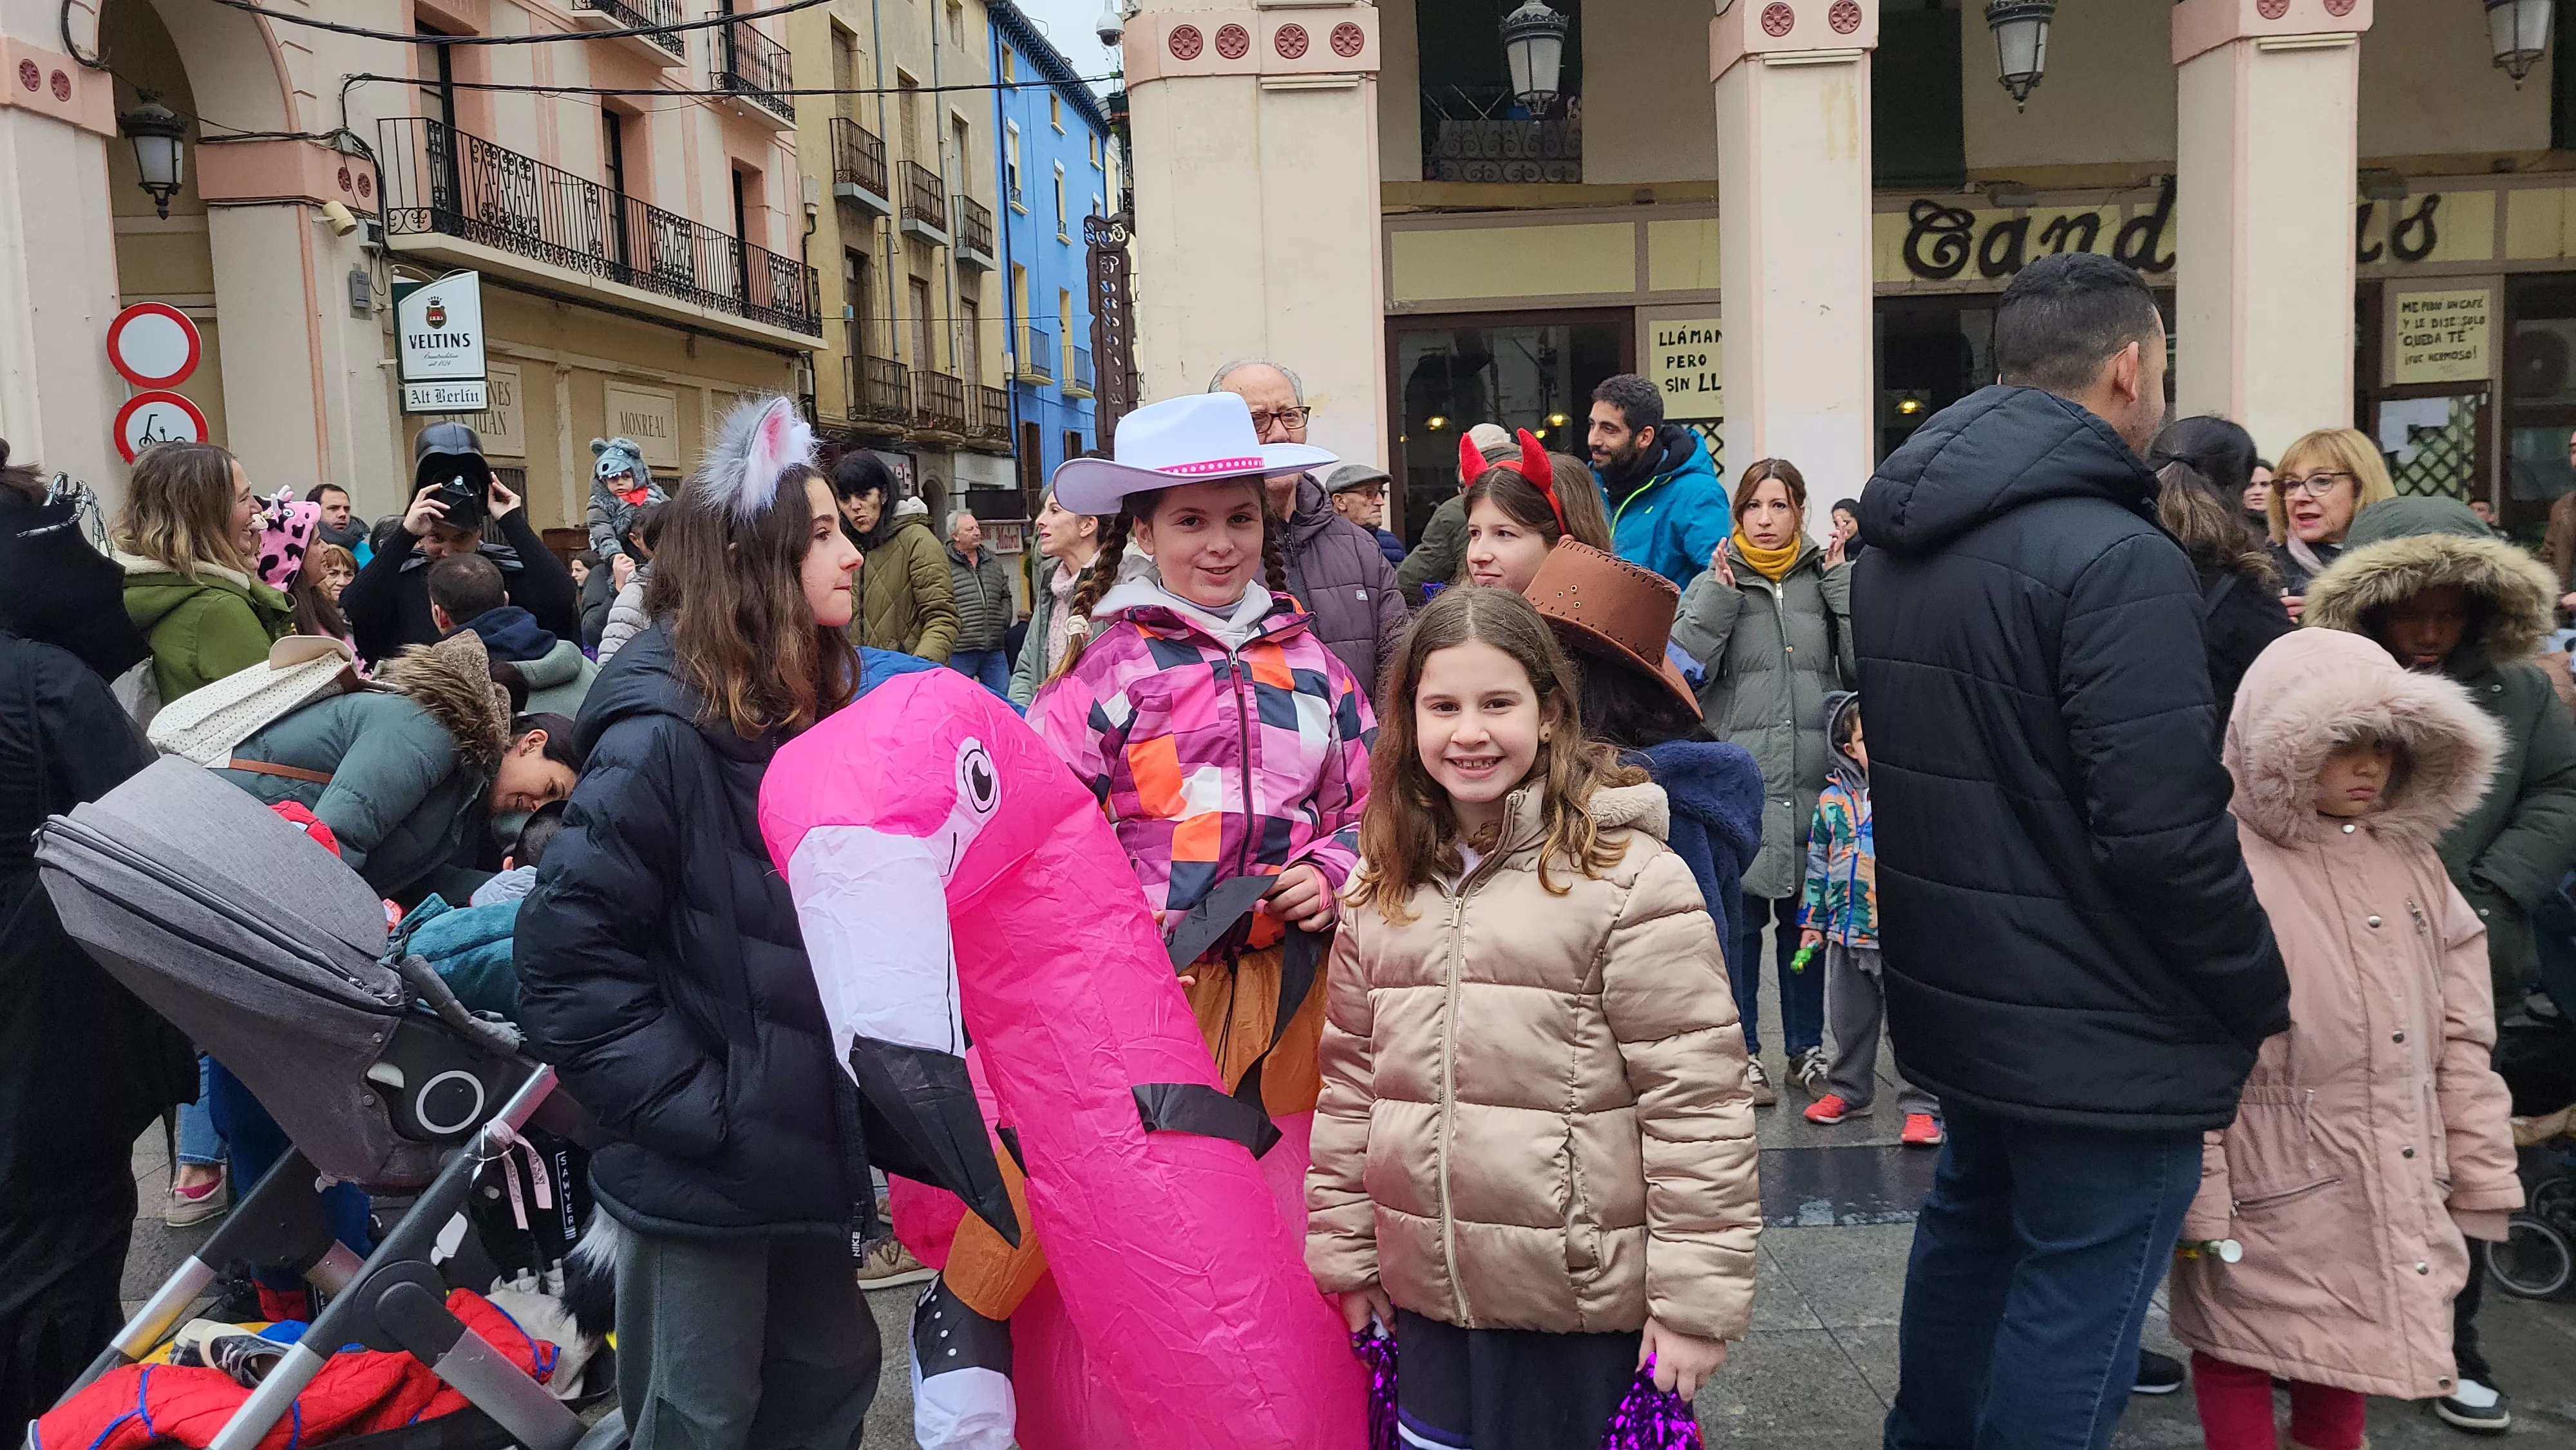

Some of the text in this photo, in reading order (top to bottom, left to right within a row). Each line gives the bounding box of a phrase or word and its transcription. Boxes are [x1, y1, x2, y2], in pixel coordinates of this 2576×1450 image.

[409, 333, 471, 349] VELTINS
[1667, 354, 1707, 369] PERO
[1665, 377, 1690, 392] SIN
[411, 390, 430, 404] Alt
[620, 411, 667, 438] MONREAL
[560, 1156, 574, 1225] SAWYER
[851, 1231, 861, 1257] NIKE
